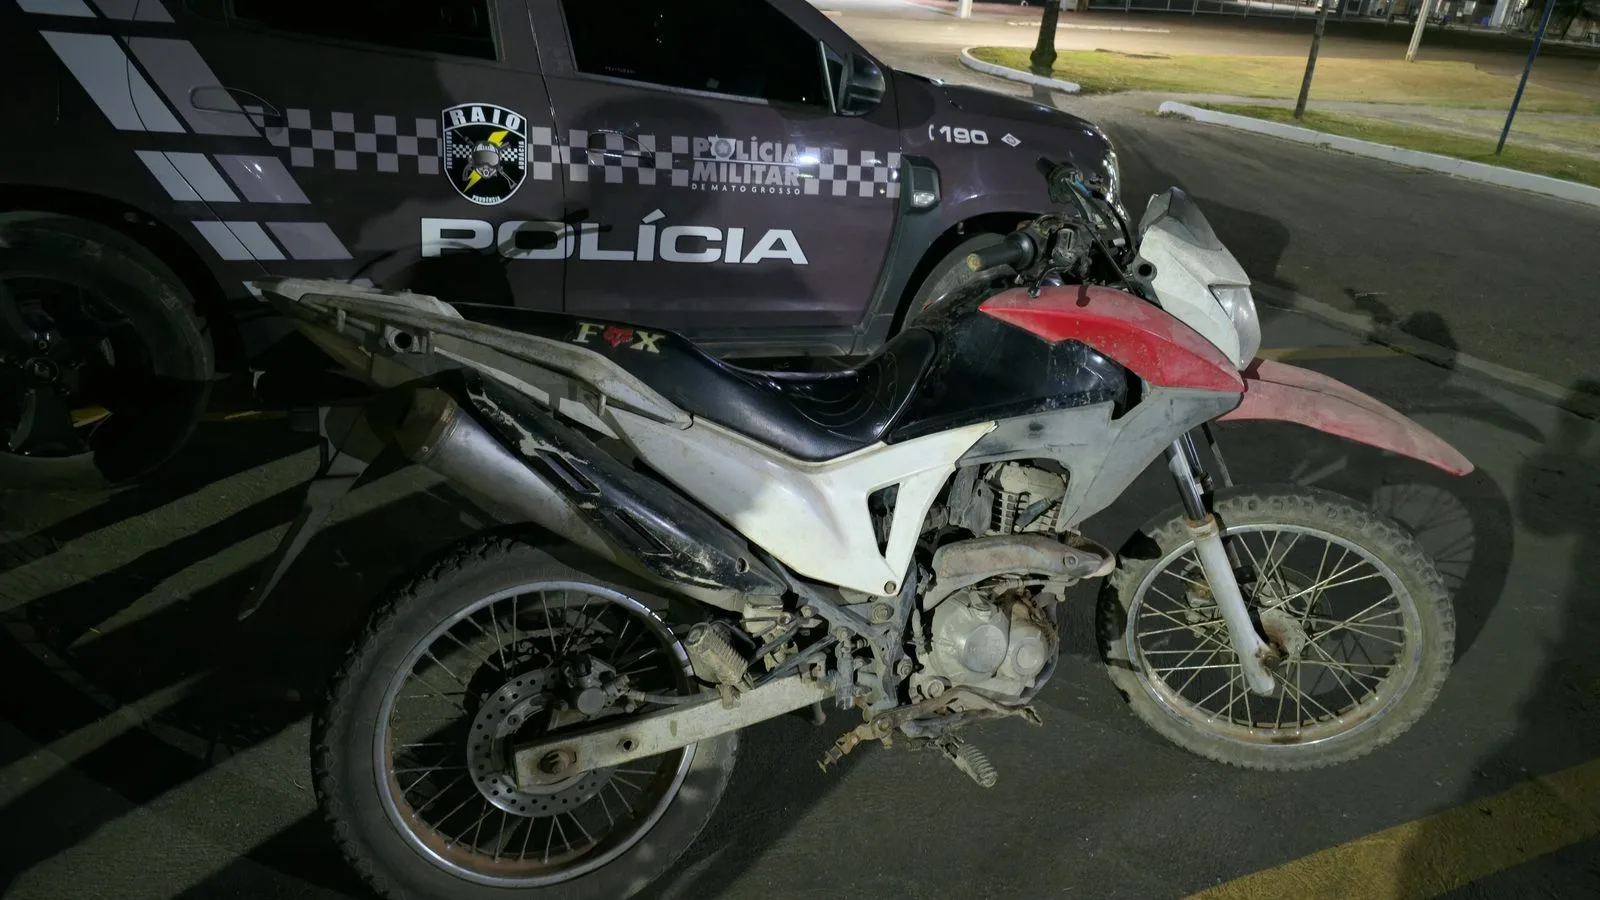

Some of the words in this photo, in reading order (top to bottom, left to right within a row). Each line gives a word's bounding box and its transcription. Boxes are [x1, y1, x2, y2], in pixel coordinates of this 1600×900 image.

[449, 106, 521, 131] RAIO
[939, 125, 989, 145] 190
[691, 161, 801, 187] MILITAR
[691, 183, 706, 191] DE
[711, 184, 747, 193] MATO
[751, 186, 801, 196] GROSSO
[421, 208, 809, 265] POLÍCIA
